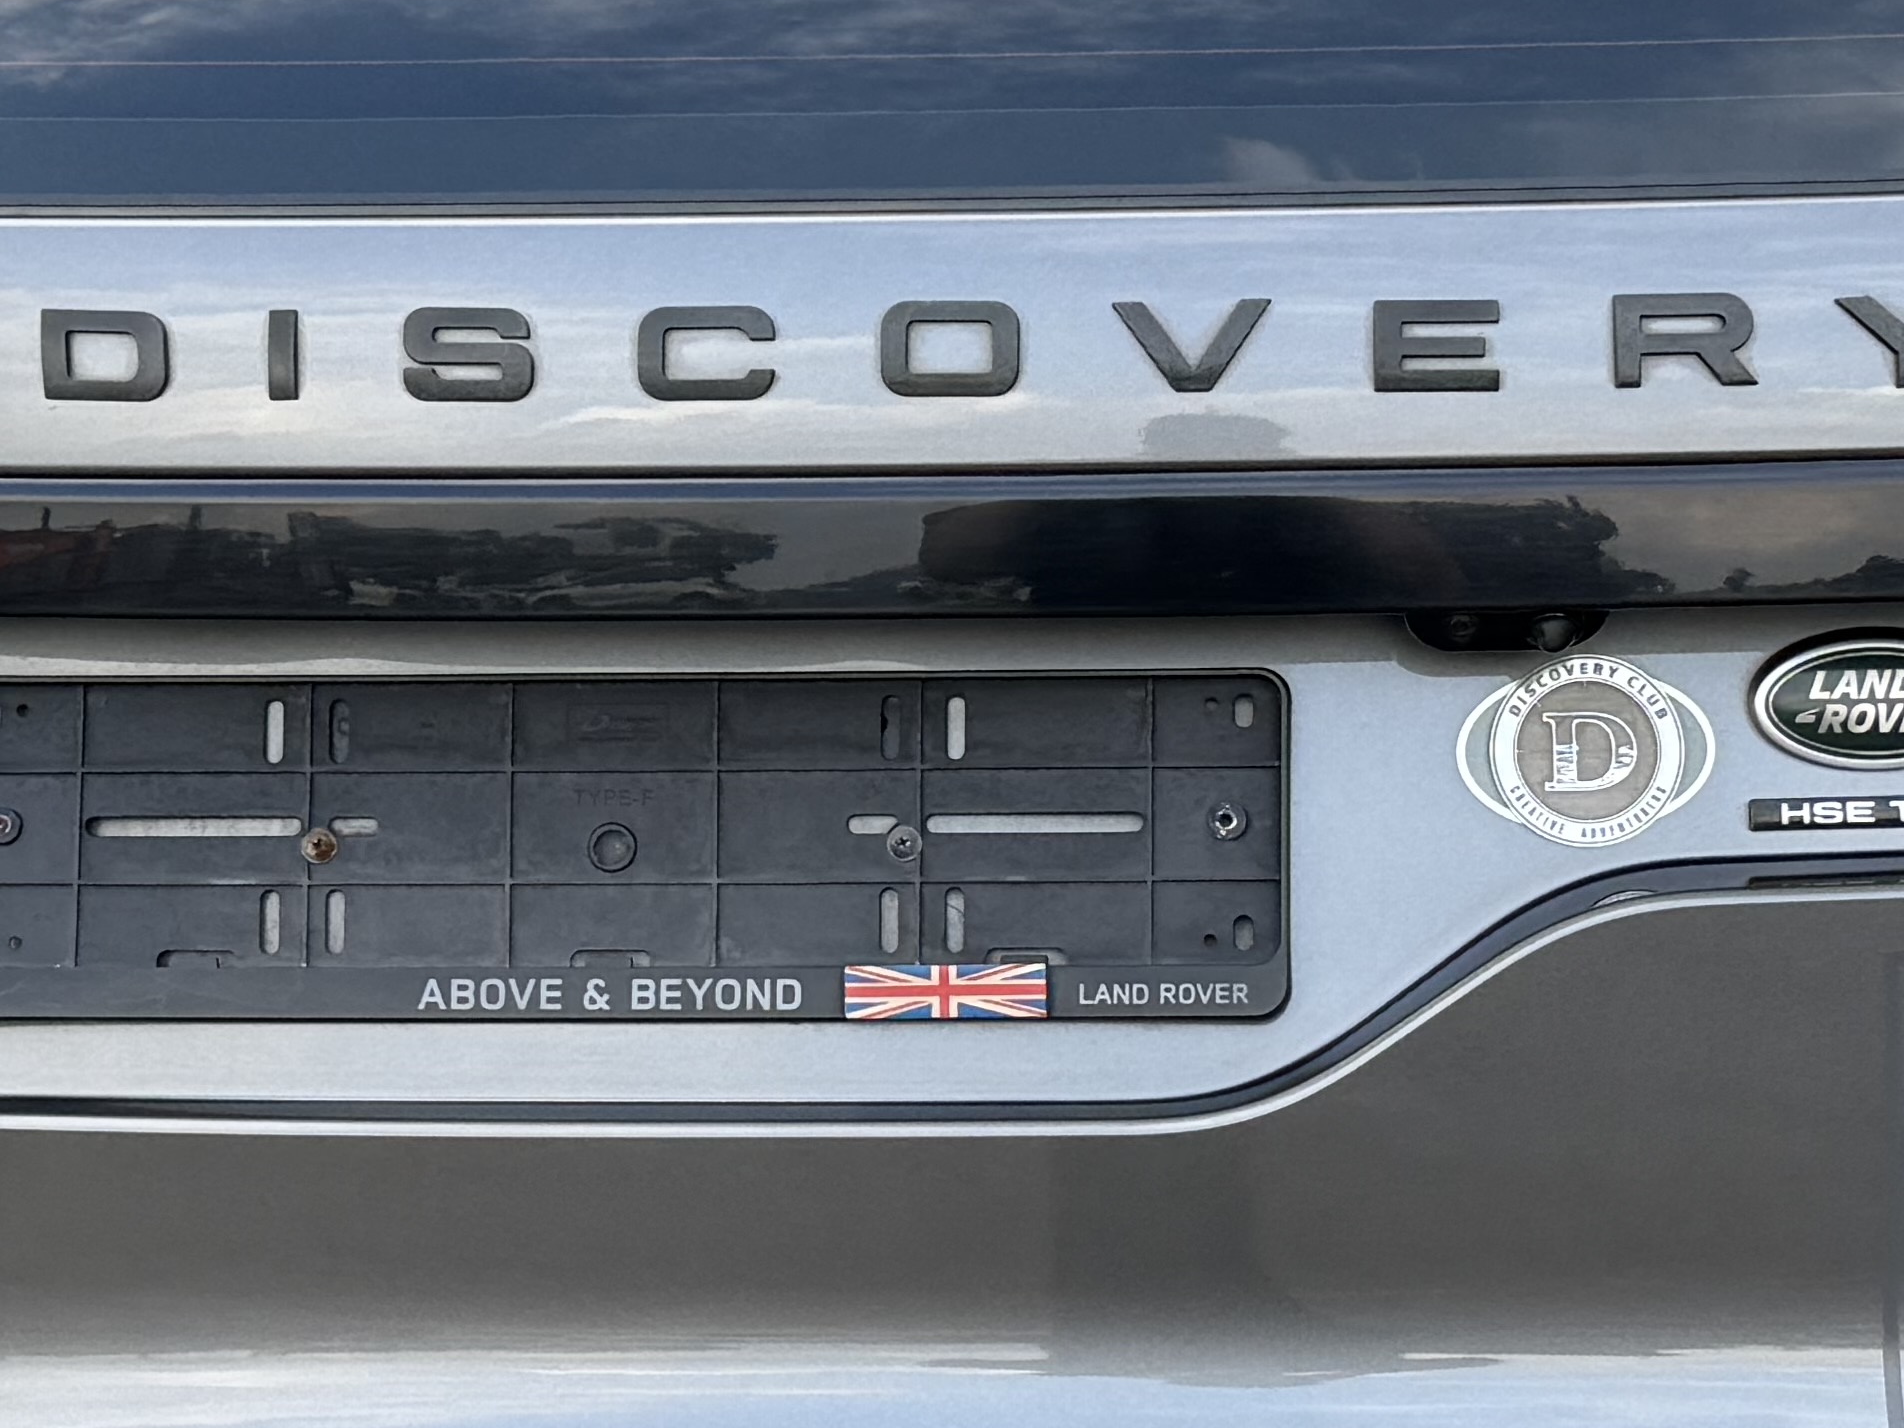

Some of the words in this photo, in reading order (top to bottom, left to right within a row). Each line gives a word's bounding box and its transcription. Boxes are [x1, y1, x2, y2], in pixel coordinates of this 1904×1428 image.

[1508, 662, 1620, 718] DISCOVERY
[1626, 676, 1669, 720] CLUB
[573, 788, 656, 808] TYPE-F
[1780, 801, 1876, 825] HSE
[417, 978, 563, 1011] ABOVE
[582, 978, 611, 1011] &
[630, 977, 804, 1011] BEYOND
[1078, 983, 1150, 1005] LAND
[1159, 983, 1249, 1005] ROVER
